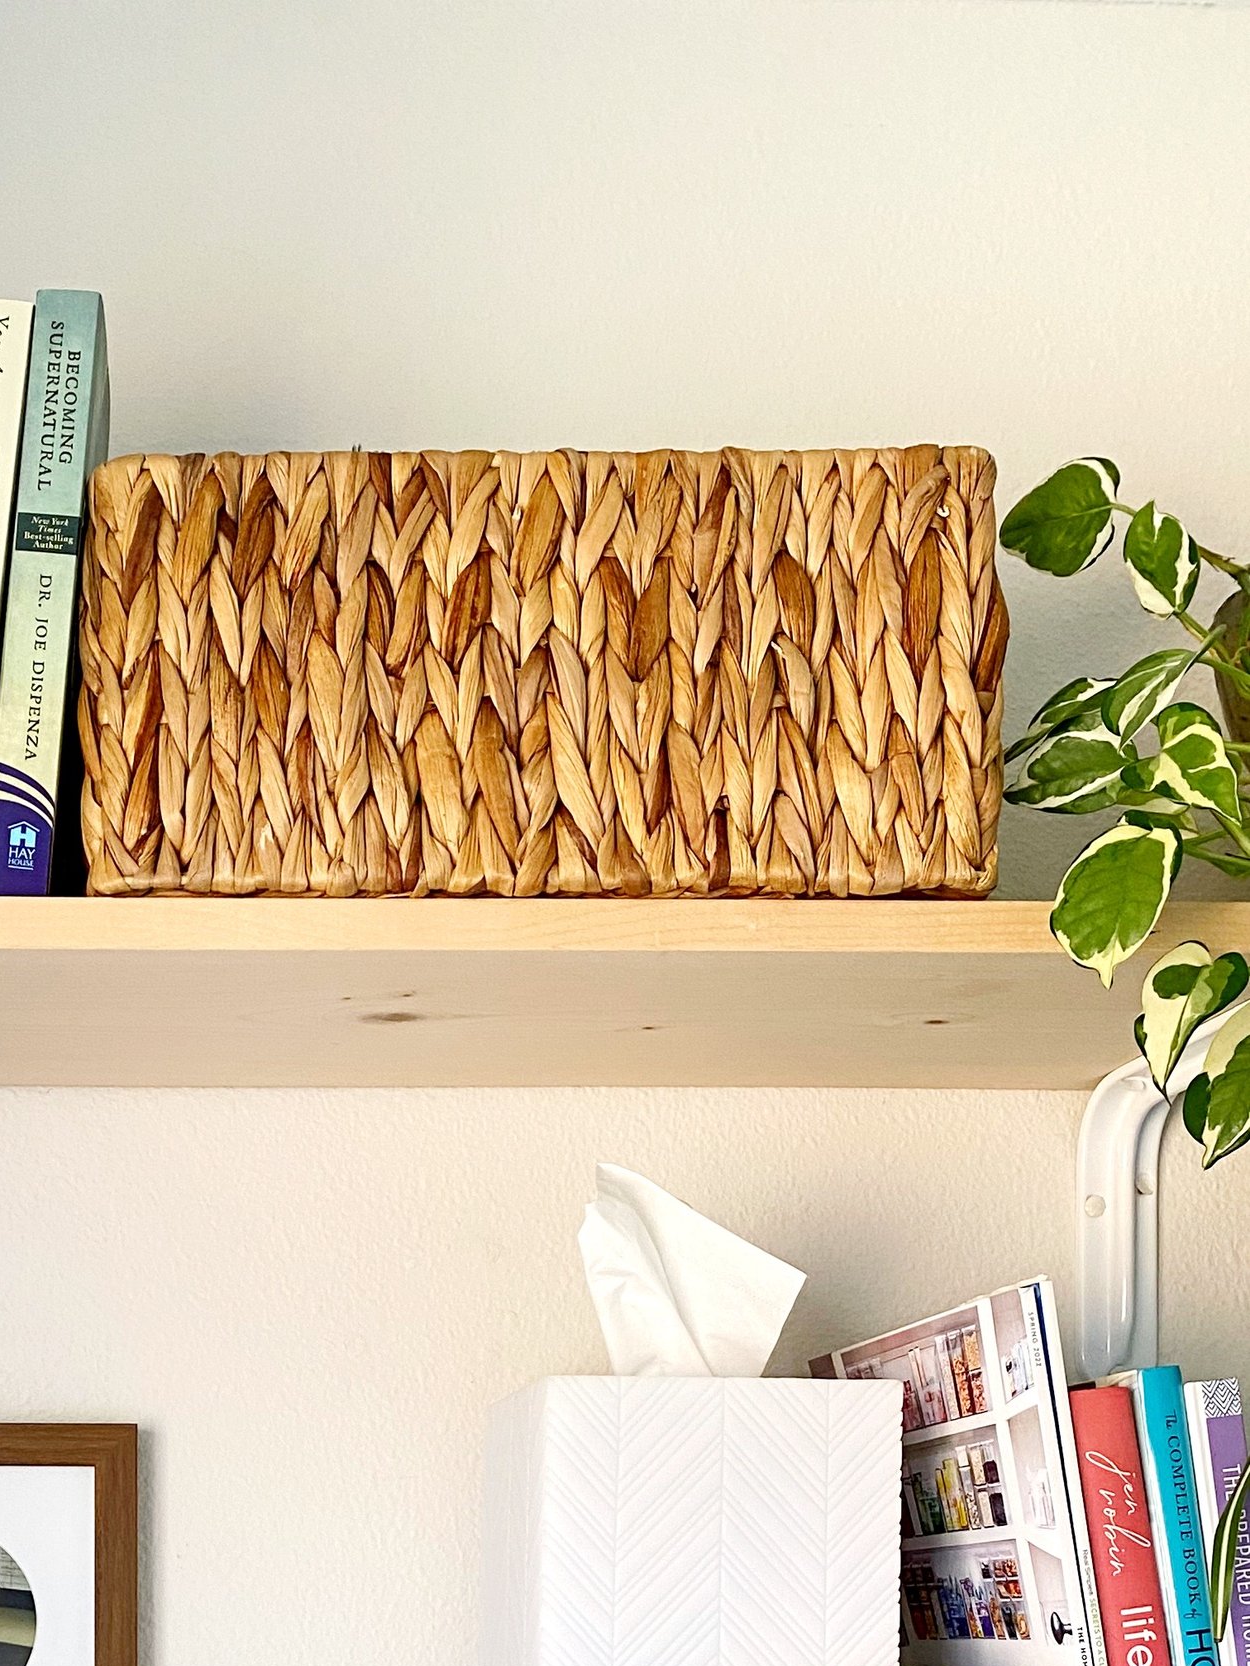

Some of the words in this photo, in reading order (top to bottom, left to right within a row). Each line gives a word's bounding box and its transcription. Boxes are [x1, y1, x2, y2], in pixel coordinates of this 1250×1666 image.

[37, 320, 65, 491] SUPERNATURAL
[58, 350, 82, 465] BECOMING
[32, 617, 49, 651] JOE
[36, 573, 53, 608] DR.
[24, 660, 46, 761] DISPENZA
[1085, 1451, 1138, 1515] jen
[1167, 1435, 1193, 1542] COMPLETE
[1183, 1548, 1201, 1604] BOOK
[1099, 1487, 1151, 1577] robin
